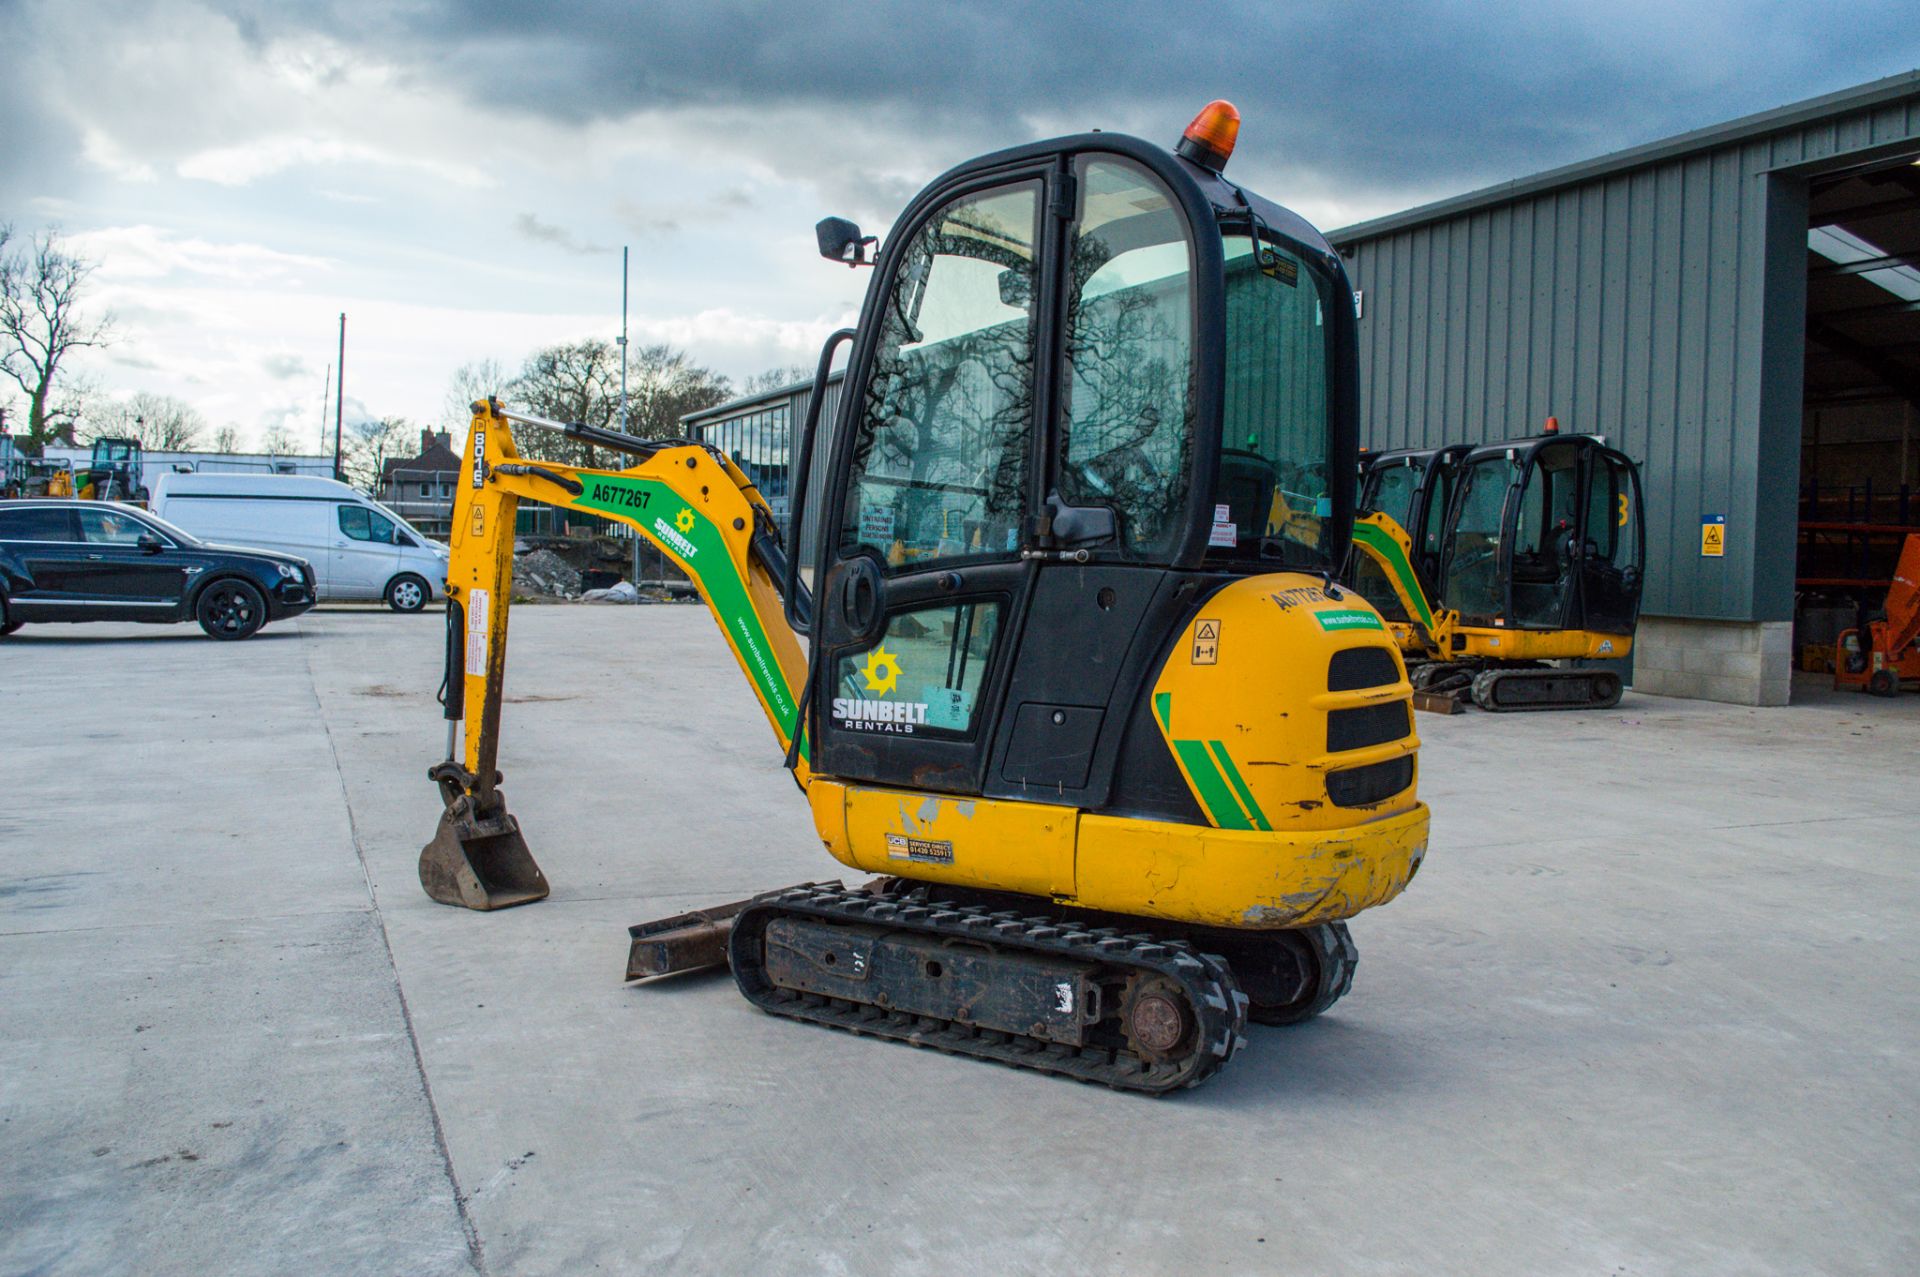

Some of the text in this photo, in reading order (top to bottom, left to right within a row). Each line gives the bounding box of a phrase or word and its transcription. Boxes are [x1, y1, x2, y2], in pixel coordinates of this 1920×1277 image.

[592, 484, 651, 509] A677267
[654, 517, 698, 558] SUNBELT
[657, 531, 688, 558] RENTALS
[738, 617, 789, 717] www.sunbeltrentals.co.uk
[832, 698, 928, 724] SUNBELT
[845, 720, 893, 733] RENTALS
